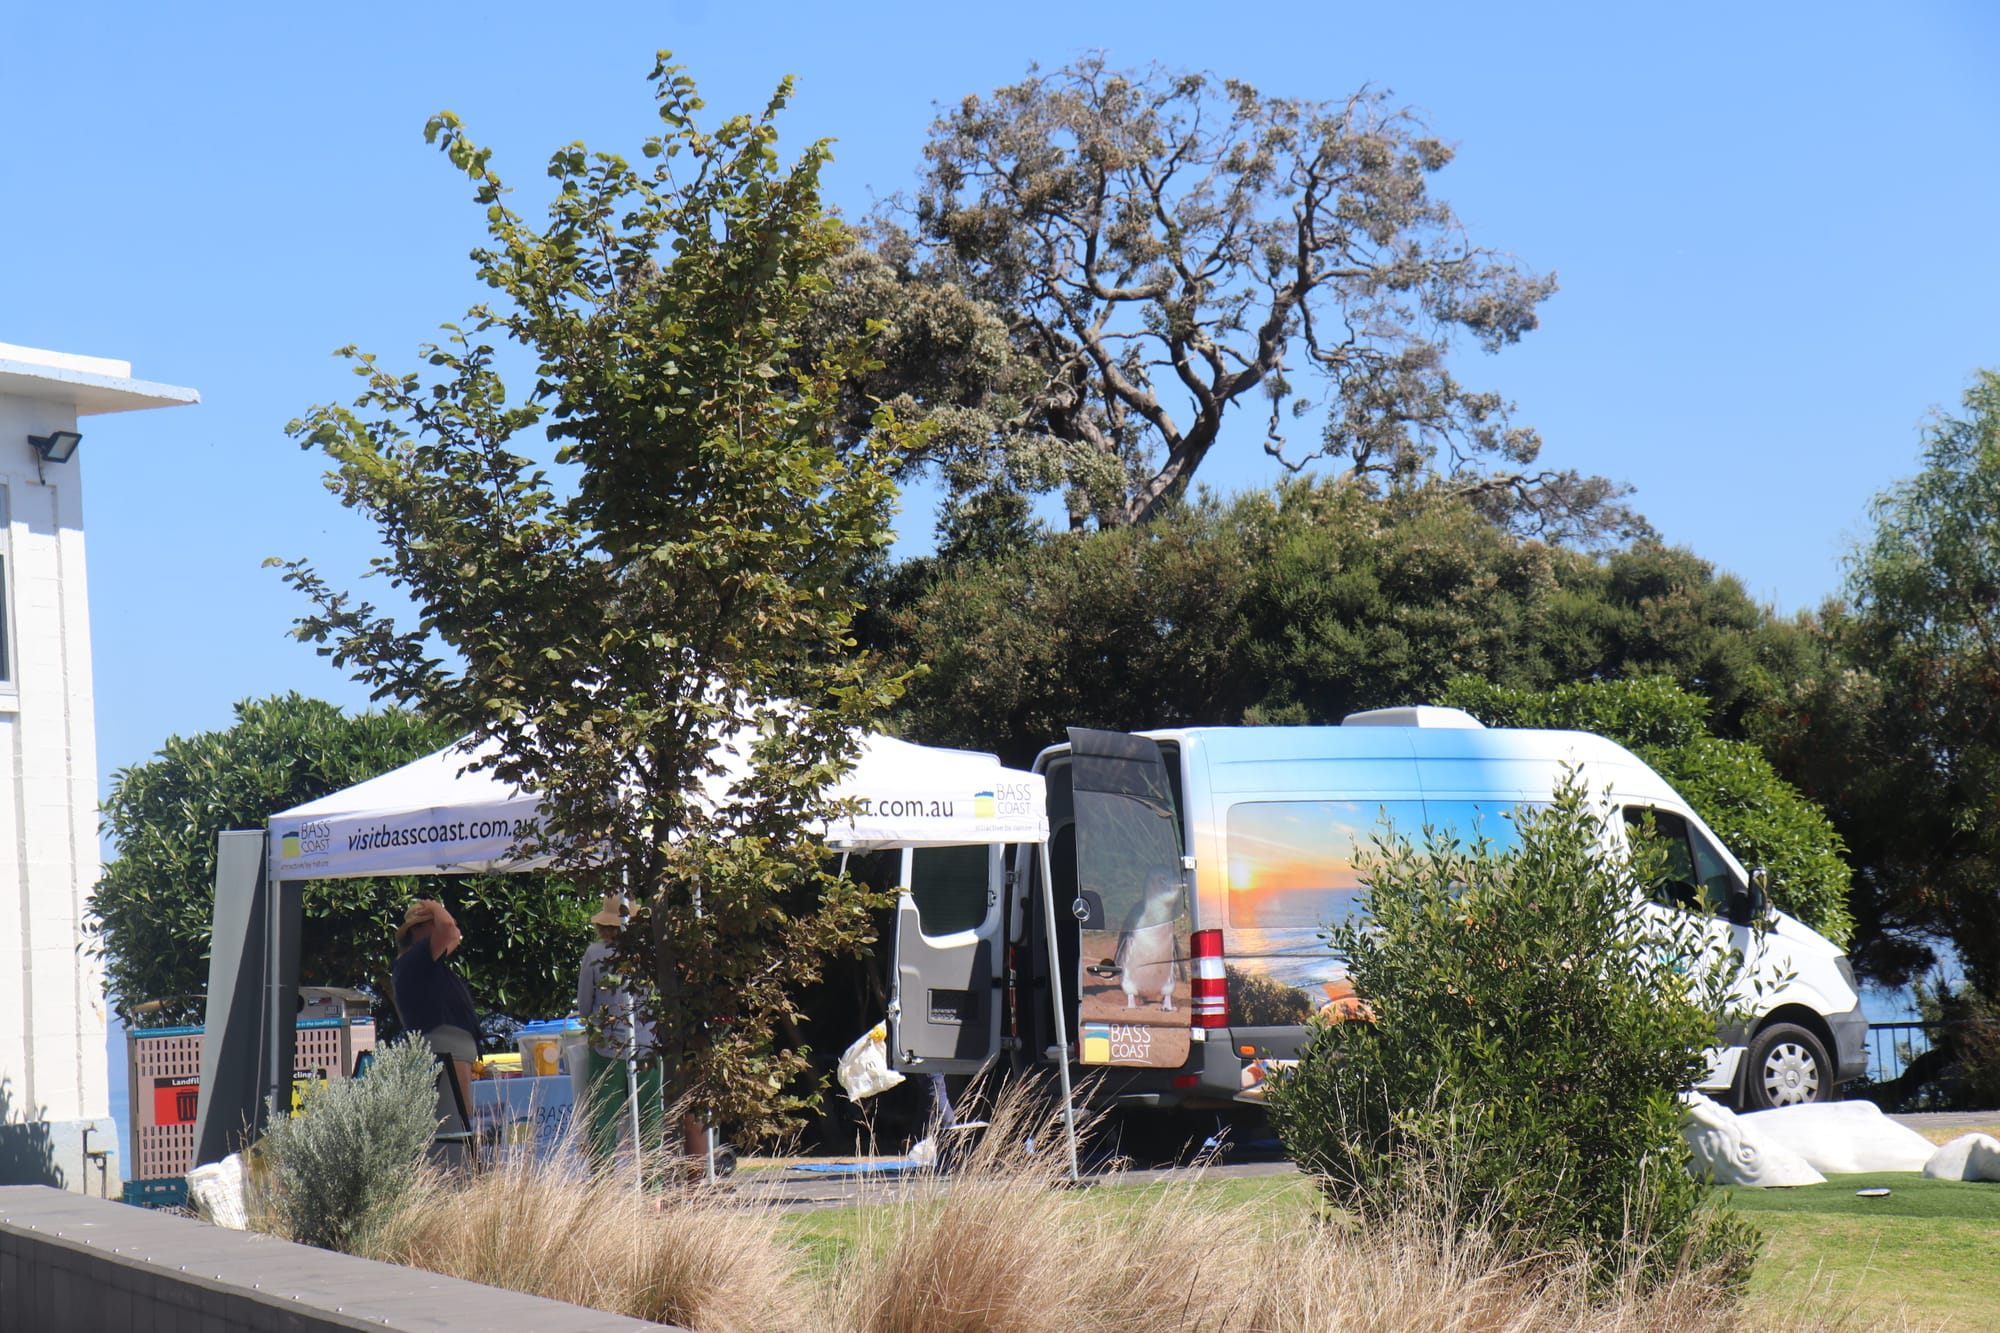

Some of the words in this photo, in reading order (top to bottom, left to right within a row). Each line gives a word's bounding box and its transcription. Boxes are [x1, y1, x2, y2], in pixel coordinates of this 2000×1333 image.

[995, 783, 1031, 801] BASS
[997, 801, 1031, 815] COAST
[300, 820, 331, 840] BASS
[301, 838, 330, 853] COAST
[1111, 1023, 1152, 1043] BASS
[1111, 1043, 1152, 1059] COAST
